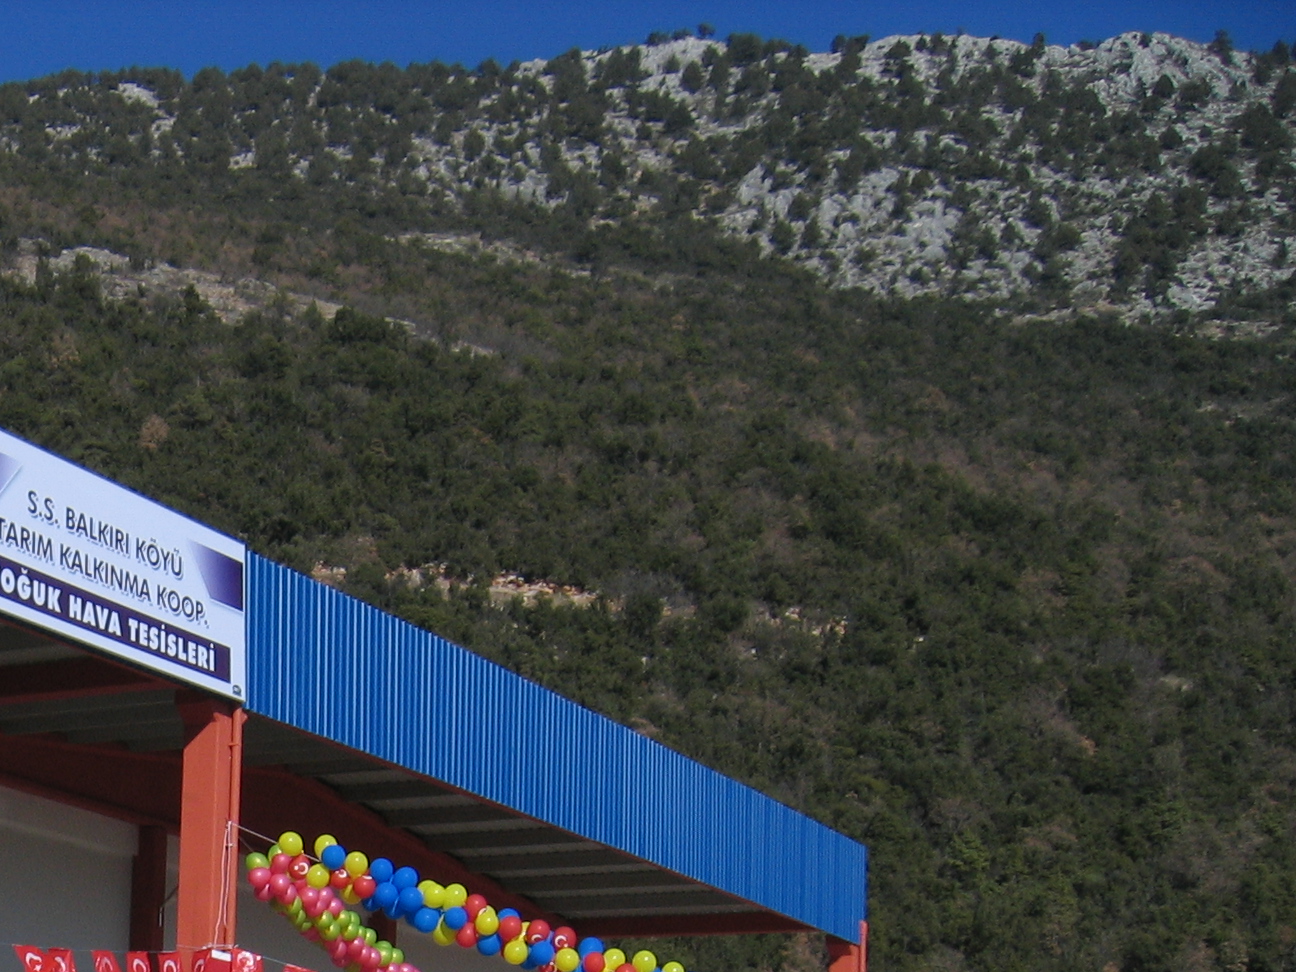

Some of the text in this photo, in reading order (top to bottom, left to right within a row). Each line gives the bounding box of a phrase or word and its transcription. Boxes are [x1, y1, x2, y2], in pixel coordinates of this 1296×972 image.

[27, 490, 183, 577] S.S. BALKIRI KÖYÜ
[59, 543, 152, 602] KALKINMA
[156, 584, 209, 626] KOOP.
[68, 595, 122, 637] HAVA
[128, 617, 216, 672] TESİSLERİ
